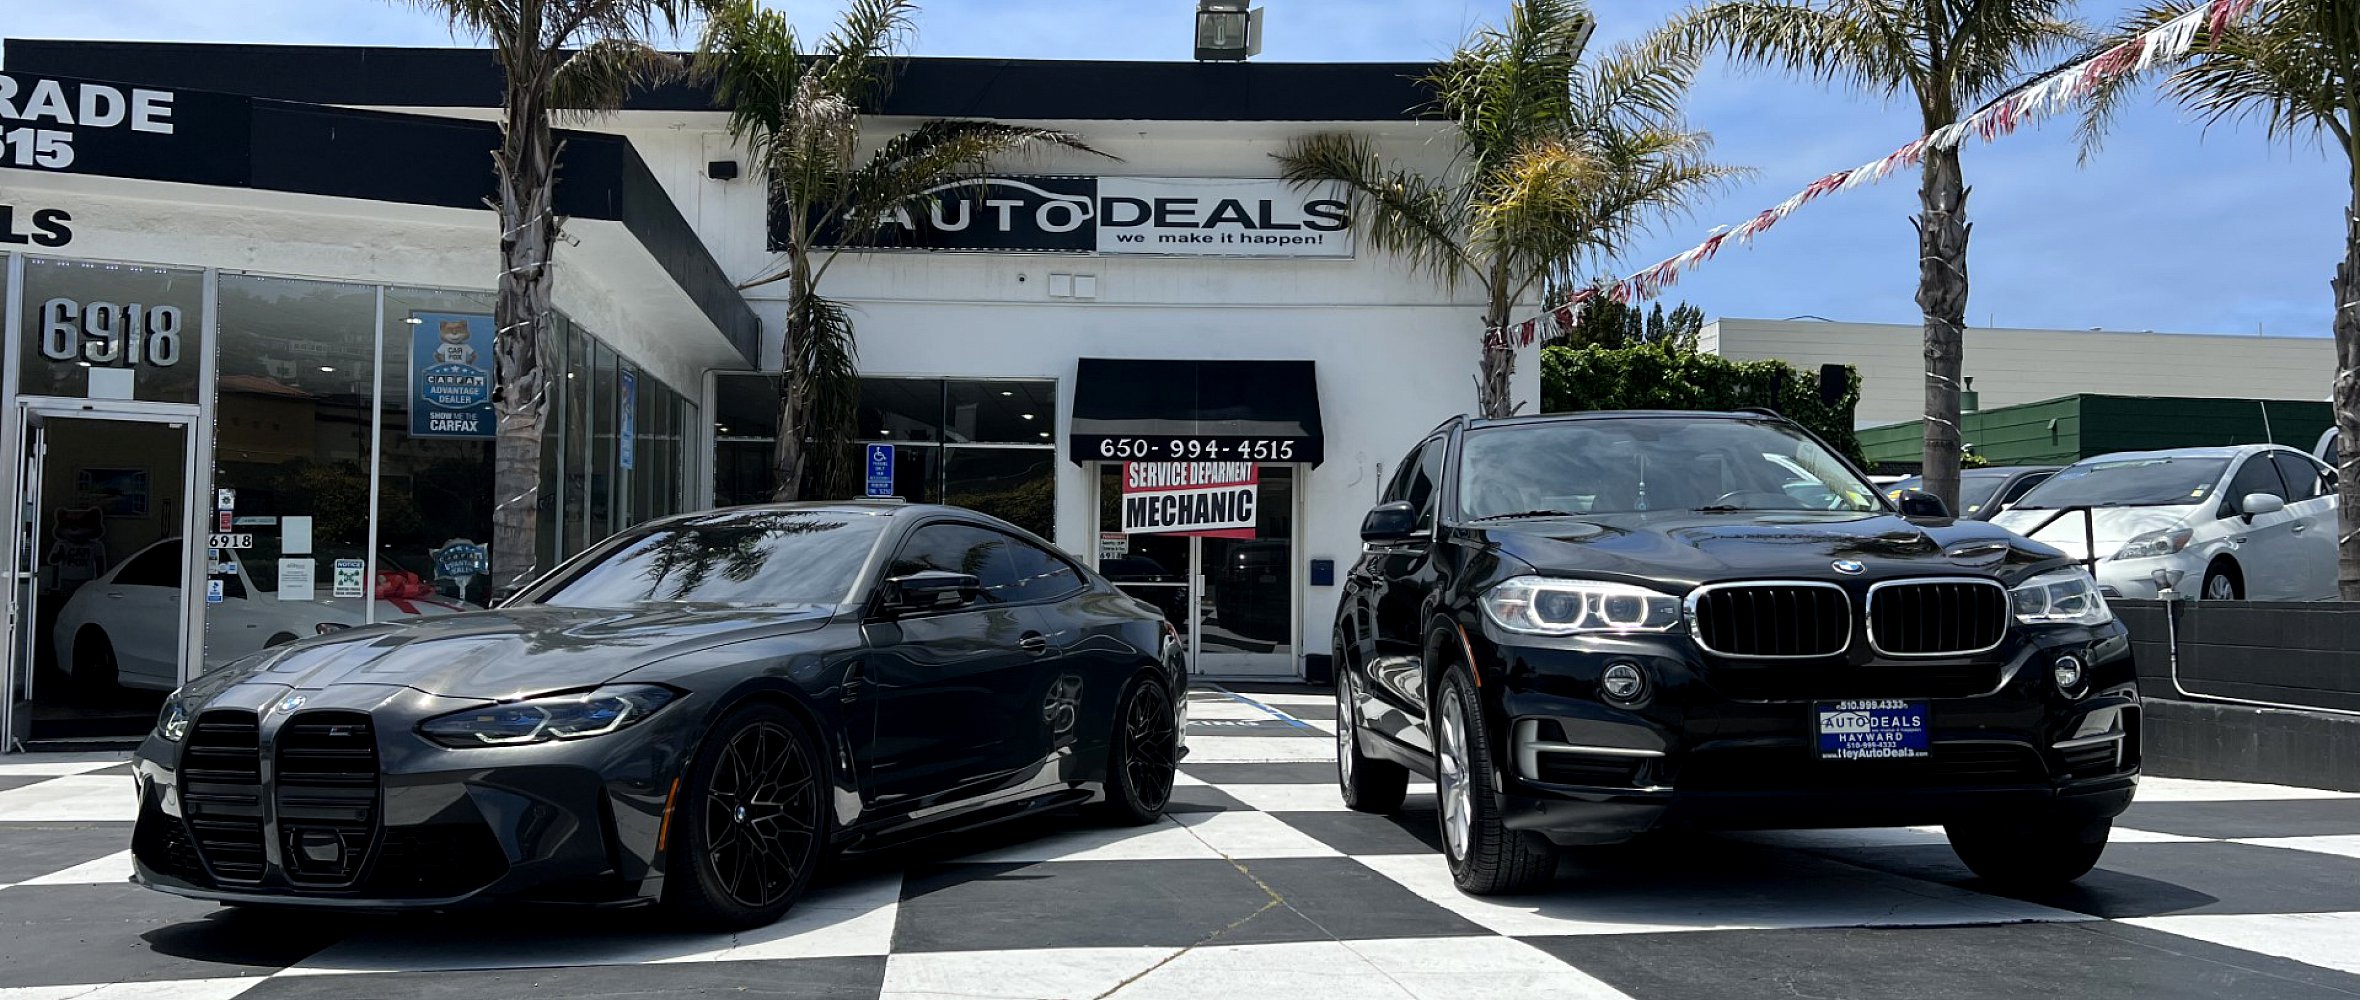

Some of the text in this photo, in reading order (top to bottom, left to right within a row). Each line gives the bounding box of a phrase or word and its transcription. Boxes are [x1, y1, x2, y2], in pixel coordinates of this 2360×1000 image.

[0, 125, 75, 169] 15
[869, 196, 1351, 233] AUTO DEALS
[1116, 232, 1323, 247] we make it happen!
[39, 297, 182, 367] 6918
[430, 386, 480, 395] ADVANTAGE
[439, 395, 472, 404] DEALER
[429, 412, 452, 420] SHOW
[429, 420, 479, 432] CARFAX
[1129, 461, 1187, 489] SERVICE
[1126, 489, 1253, 529] MECHANIC
[209, 535, 252, 548] 6918
[1840, 700, 1904, 710] 510.999.4333
[1825, 716, 1921, 728] AUTO DEALS
[1839, 732, 1904, 742] HAYWARD
